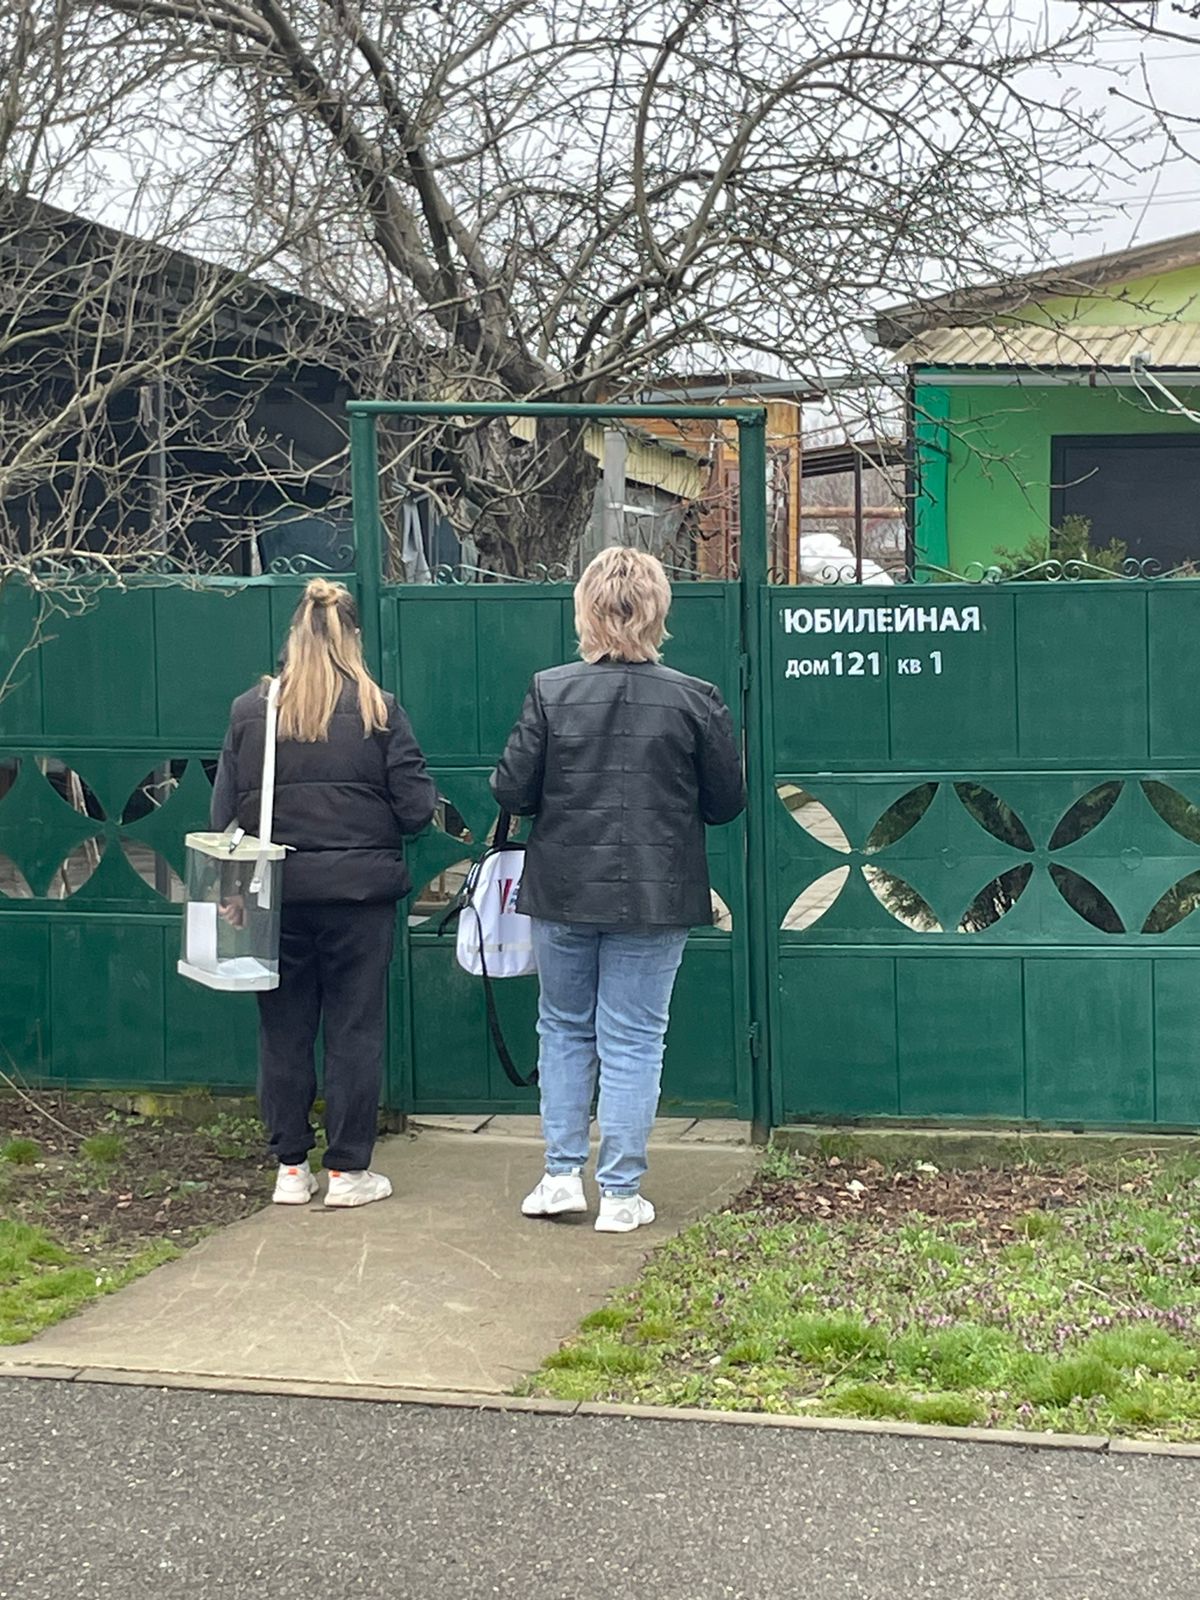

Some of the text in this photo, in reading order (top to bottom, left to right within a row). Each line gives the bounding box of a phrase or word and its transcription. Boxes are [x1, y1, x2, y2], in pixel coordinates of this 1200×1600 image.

[784, 604, 980, 633] ЮБИЛЕЙНАЯ
[897, 658, 921, 675] кв
[929, 651, 942, 674] 1
